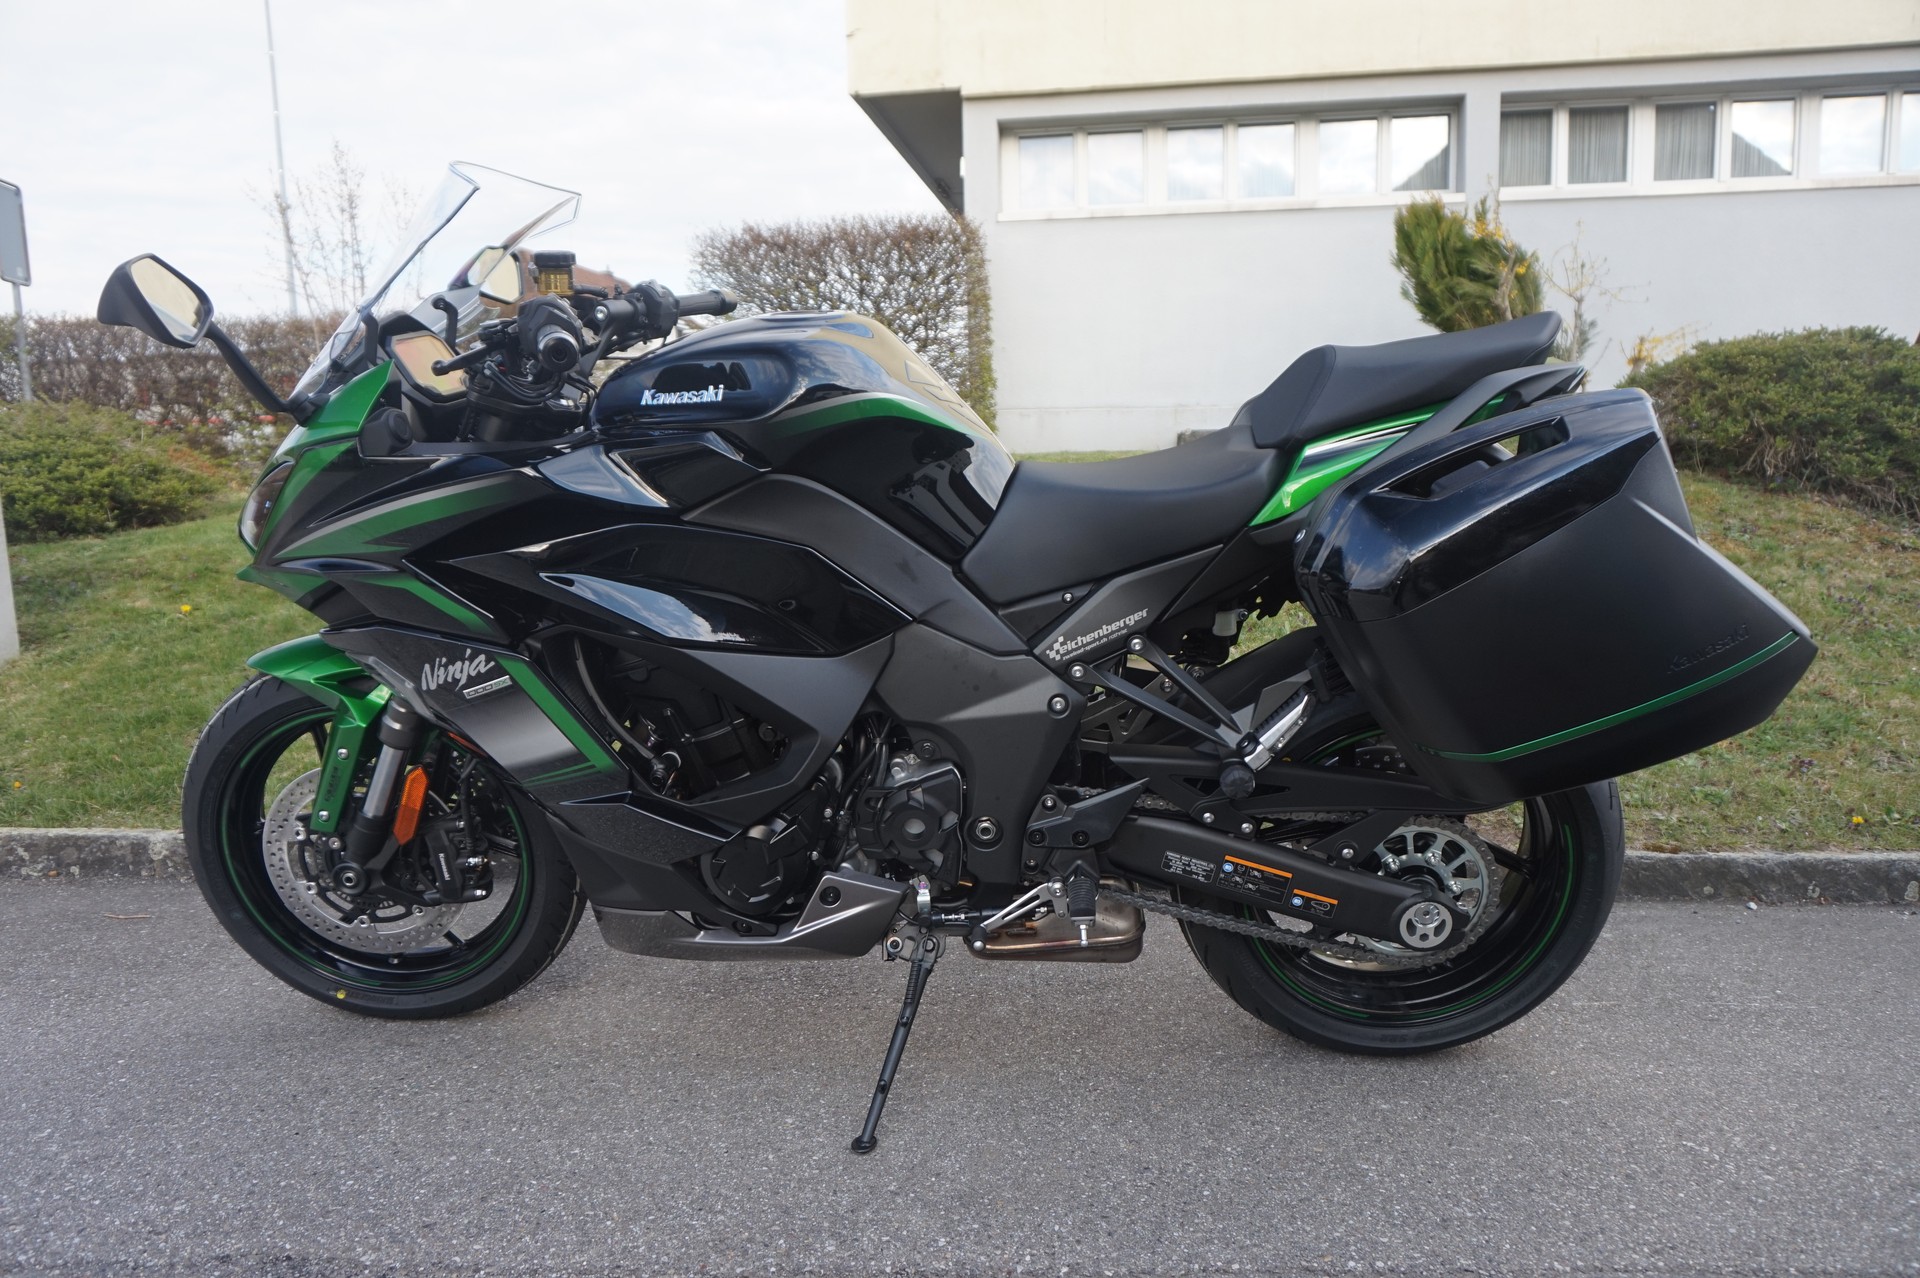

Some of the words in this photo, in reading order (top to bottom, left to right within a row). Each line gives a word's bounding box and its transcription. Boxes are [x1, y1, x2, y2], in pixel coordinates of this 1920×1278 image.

[640, 384, 724, 406] Kawasaki
[1059, 608, 1149, 655] eichenberger
[1667, 623, 1750, 674] Kawasaki
[421, 648, 495, 692] Ninja
